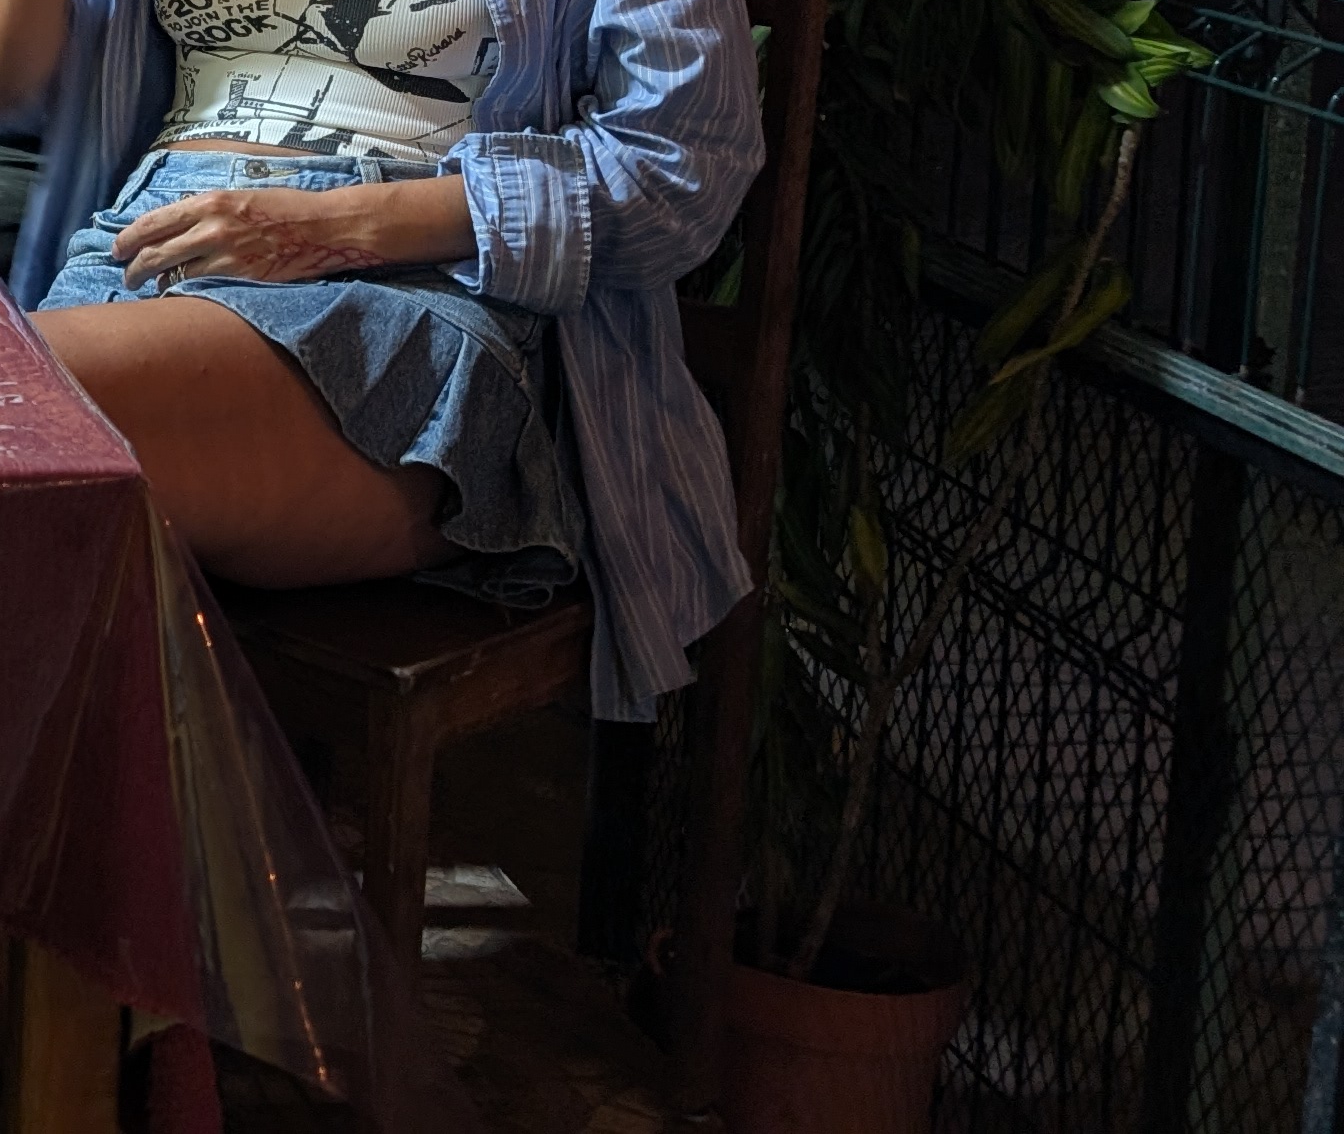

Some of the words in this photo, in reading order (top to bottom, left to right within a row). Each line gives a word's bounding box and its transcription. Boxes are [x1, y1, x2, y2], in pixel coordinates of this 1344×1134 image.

[222, 0, 270, 17] THE
[184, 14, 279, 44] ROCK
[406, 27, 467, 67] Richard
